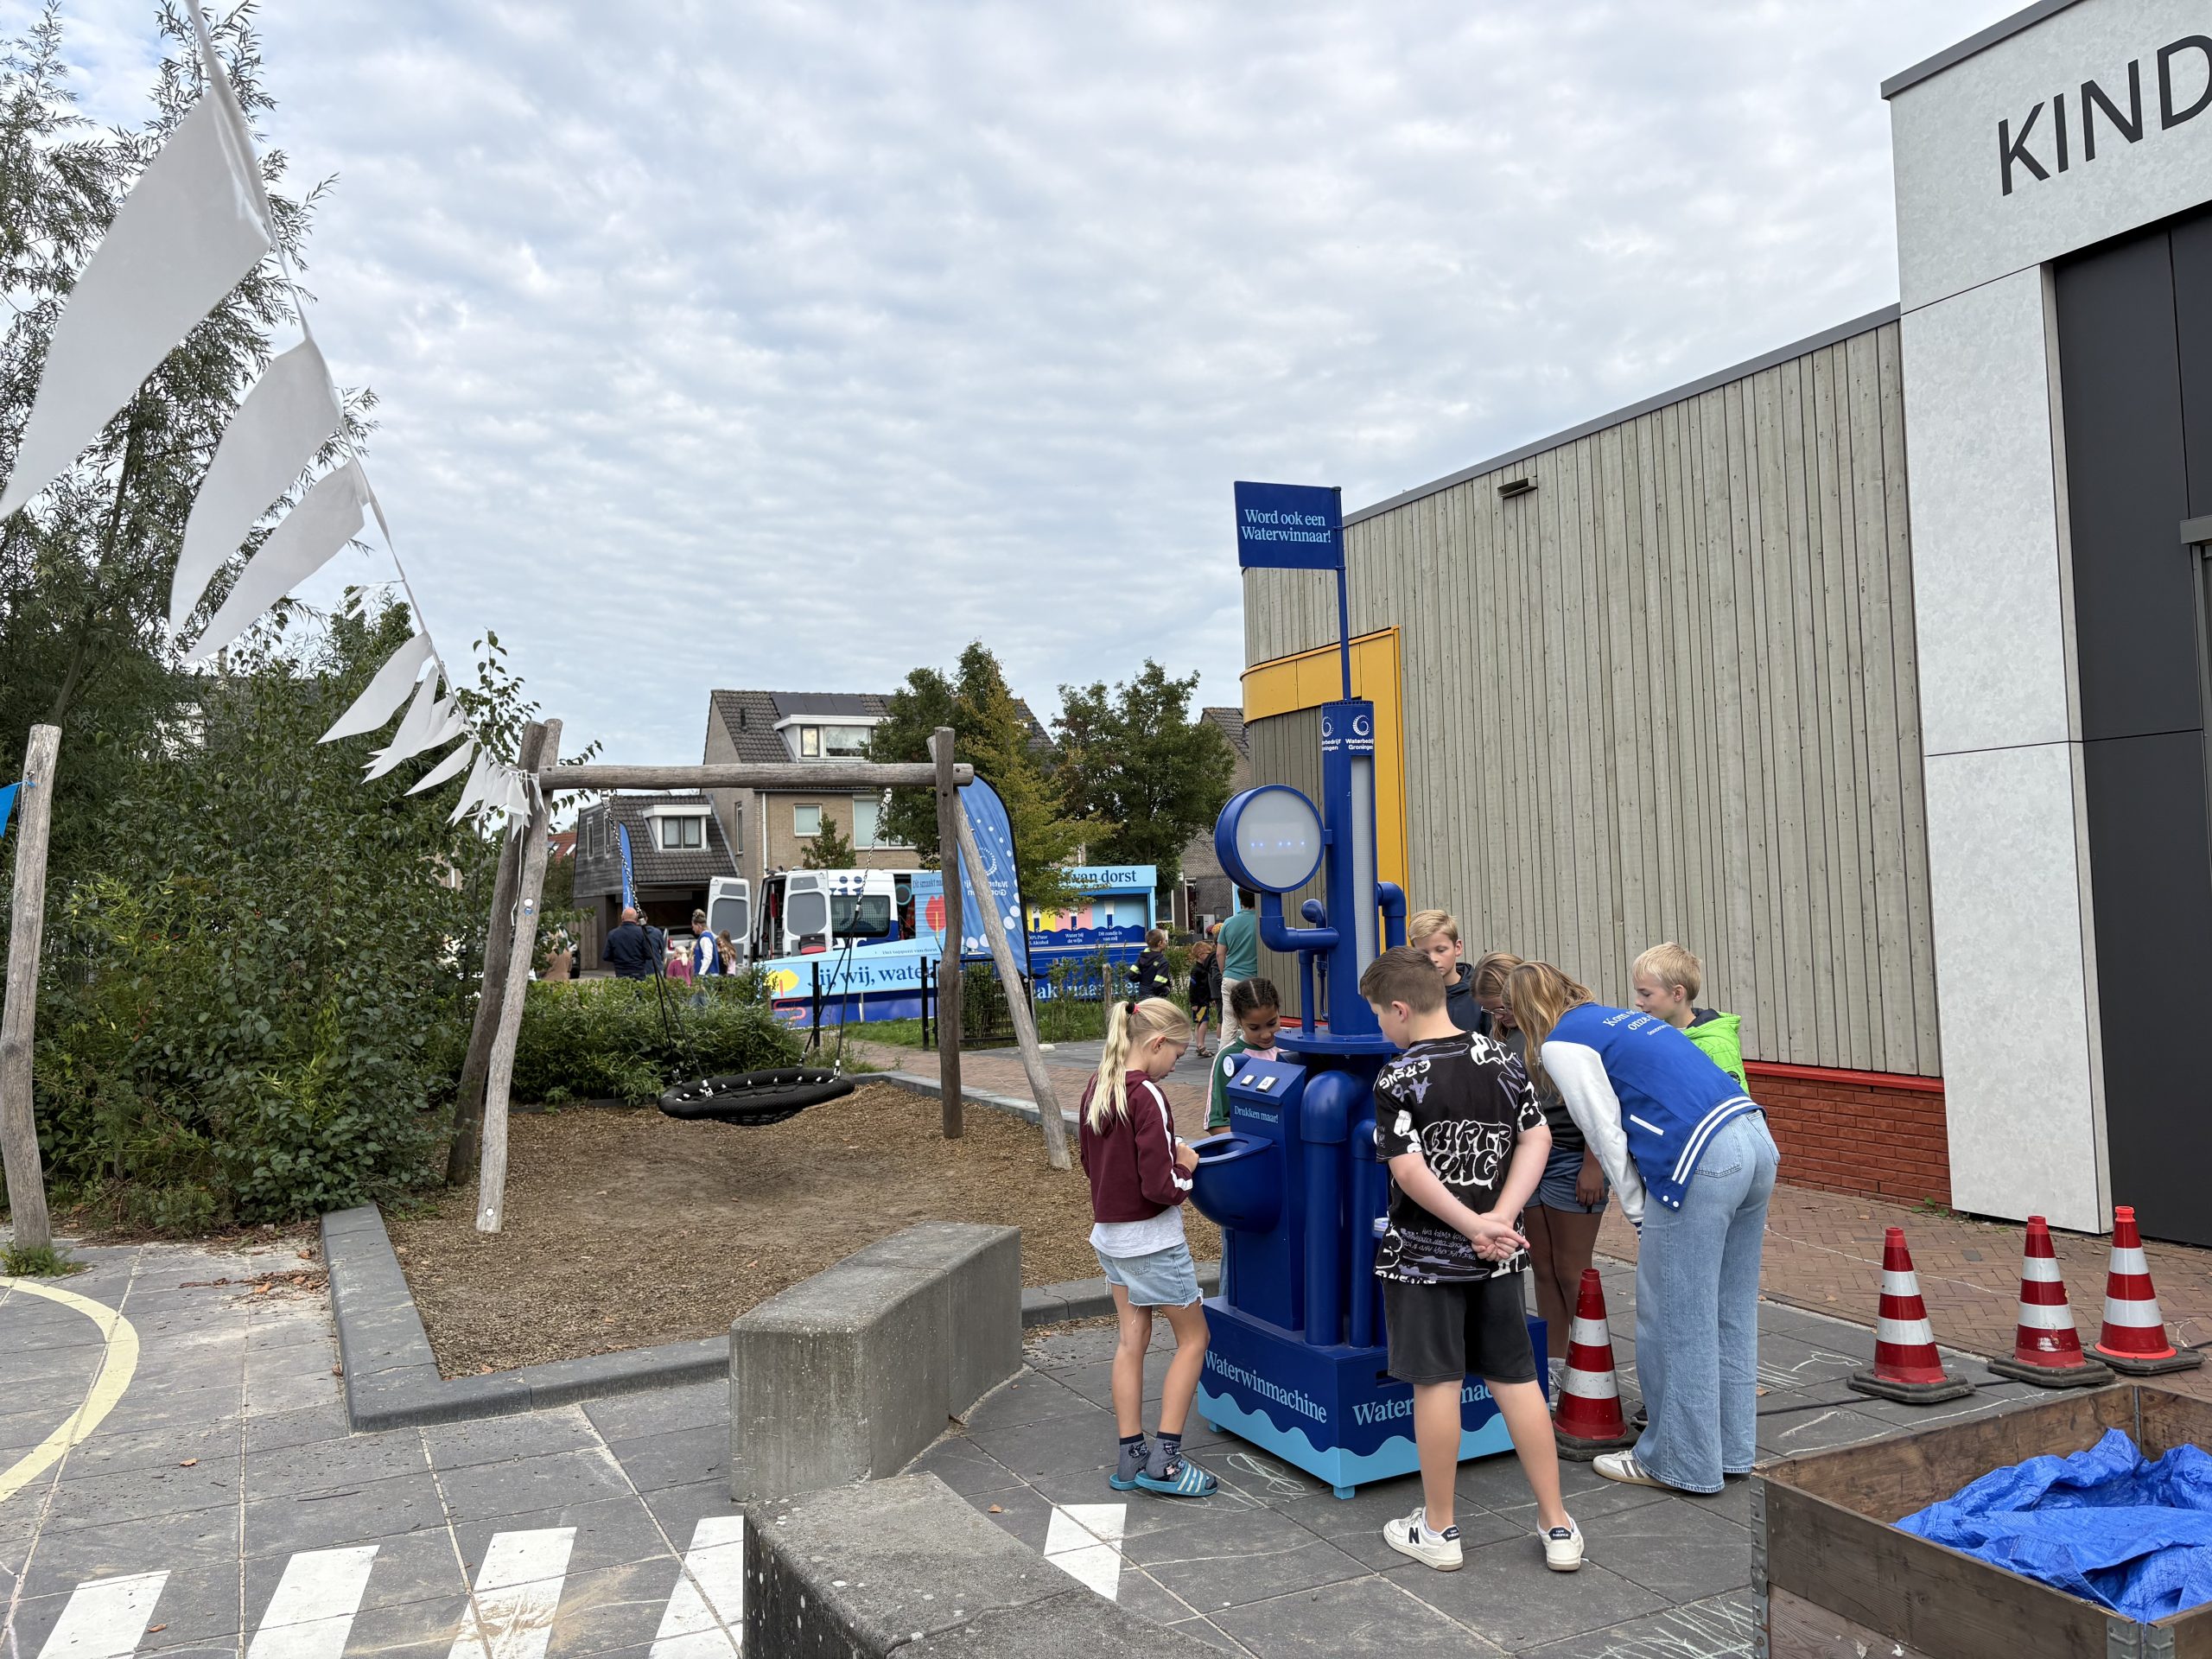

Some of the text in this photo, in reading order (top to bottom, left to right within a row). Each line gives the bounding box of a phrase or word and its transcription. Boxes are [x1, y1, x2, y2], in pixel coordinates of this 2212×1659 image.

[1998, 35, 2212, 197] KIND
[1244, 509, 1325, 526] Word ook een
[1241, 525, 1331, 543] Waterwinnaar!
[1101, 869, 1137, 882] dorst
[840, 966, 875, 987] wij,
[1234, 1106, 1279, 1124] Drukken maar!
[1205, 1349, 1327, 1424] Waterwinmachine
